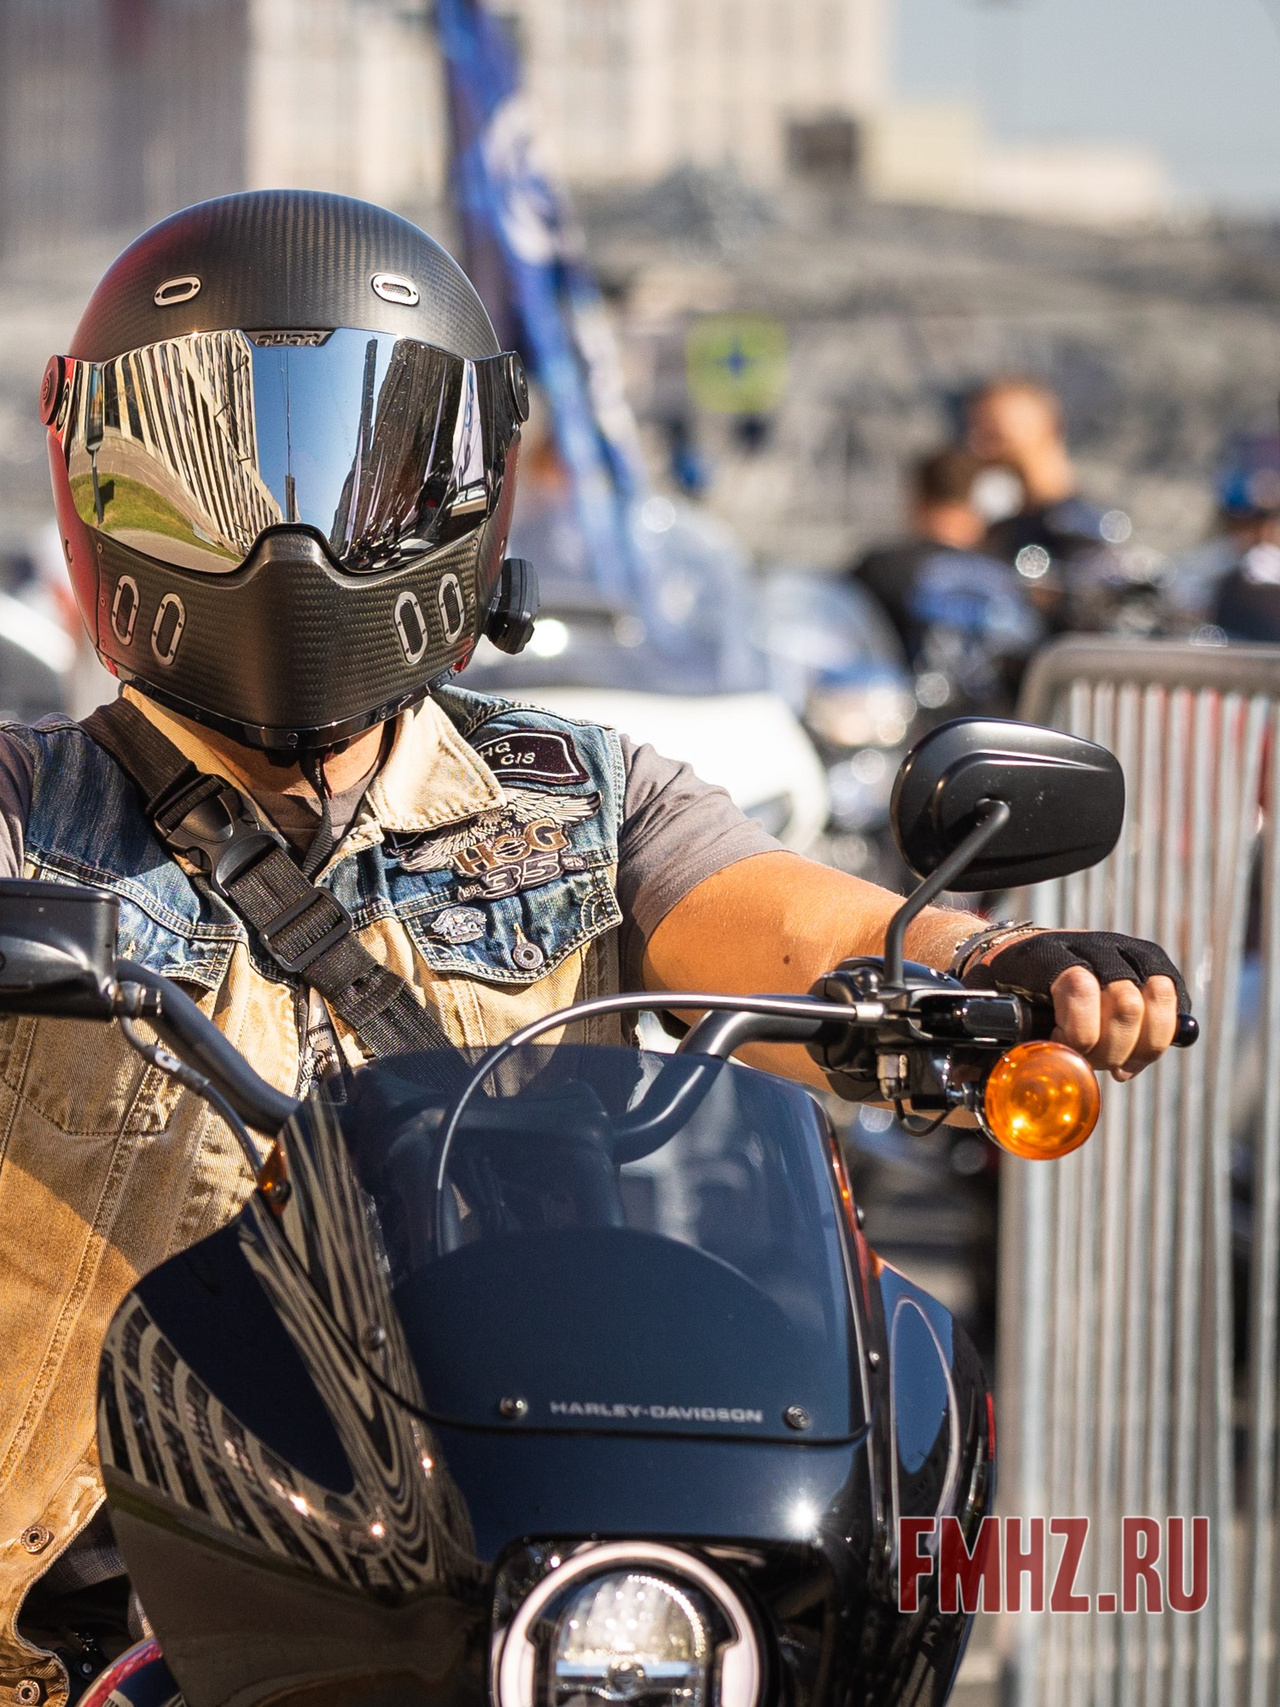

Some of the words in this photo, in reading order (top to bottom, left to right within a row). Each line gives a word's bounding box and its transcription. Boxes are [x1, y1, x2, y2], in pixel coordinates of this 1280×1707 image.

[479, 741, 512, 760] HQ
[500, 751, 536, 766] CIS
[483, 852, 561, 897] 35
[549, 1400, 764, 1424] HARLEY-DAVIDSON
